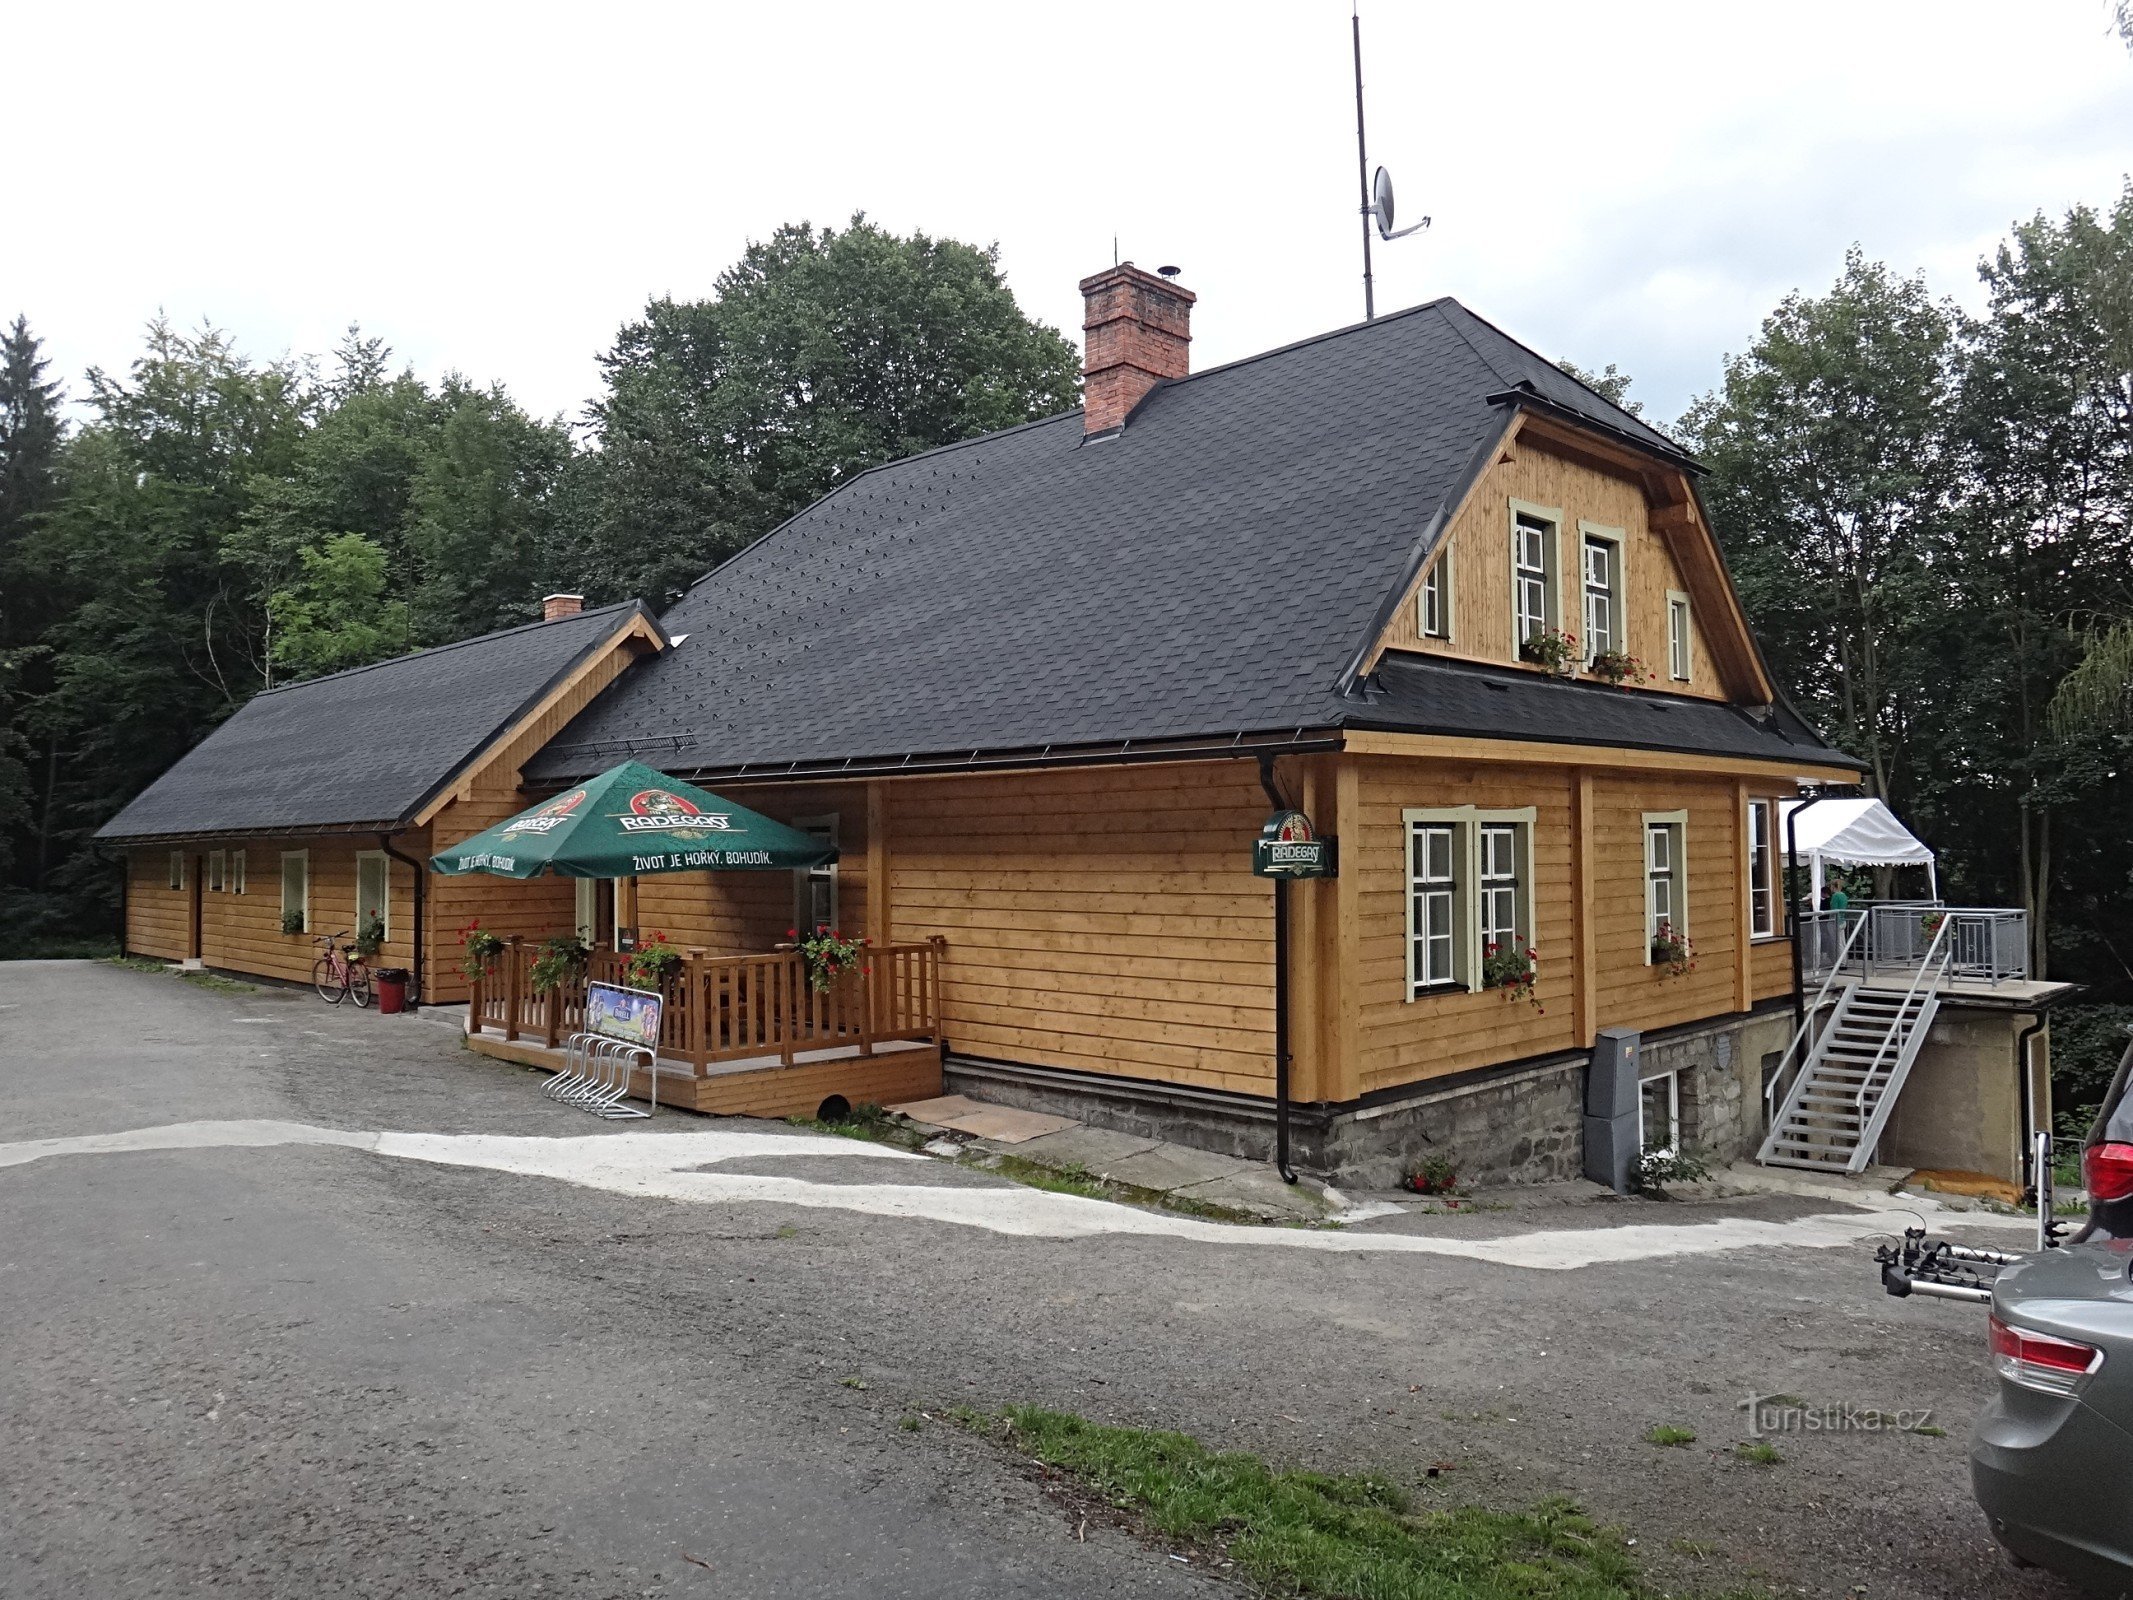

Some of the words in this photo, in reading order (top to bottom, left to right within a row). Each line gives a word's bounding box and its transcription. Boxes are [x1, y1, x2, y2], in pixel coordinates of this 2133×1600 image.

[619, 815, 730, 831] RADEGAST
[632, 855, 665, 871] ŽIVOT
[670, 853, 682, 868] JE
[685, 850, 723, 866] HOŘKÝ.
[726, 850, 773, 865] BOHUDÍK.
[1272, 846, 1319, 863] RADEGAST
